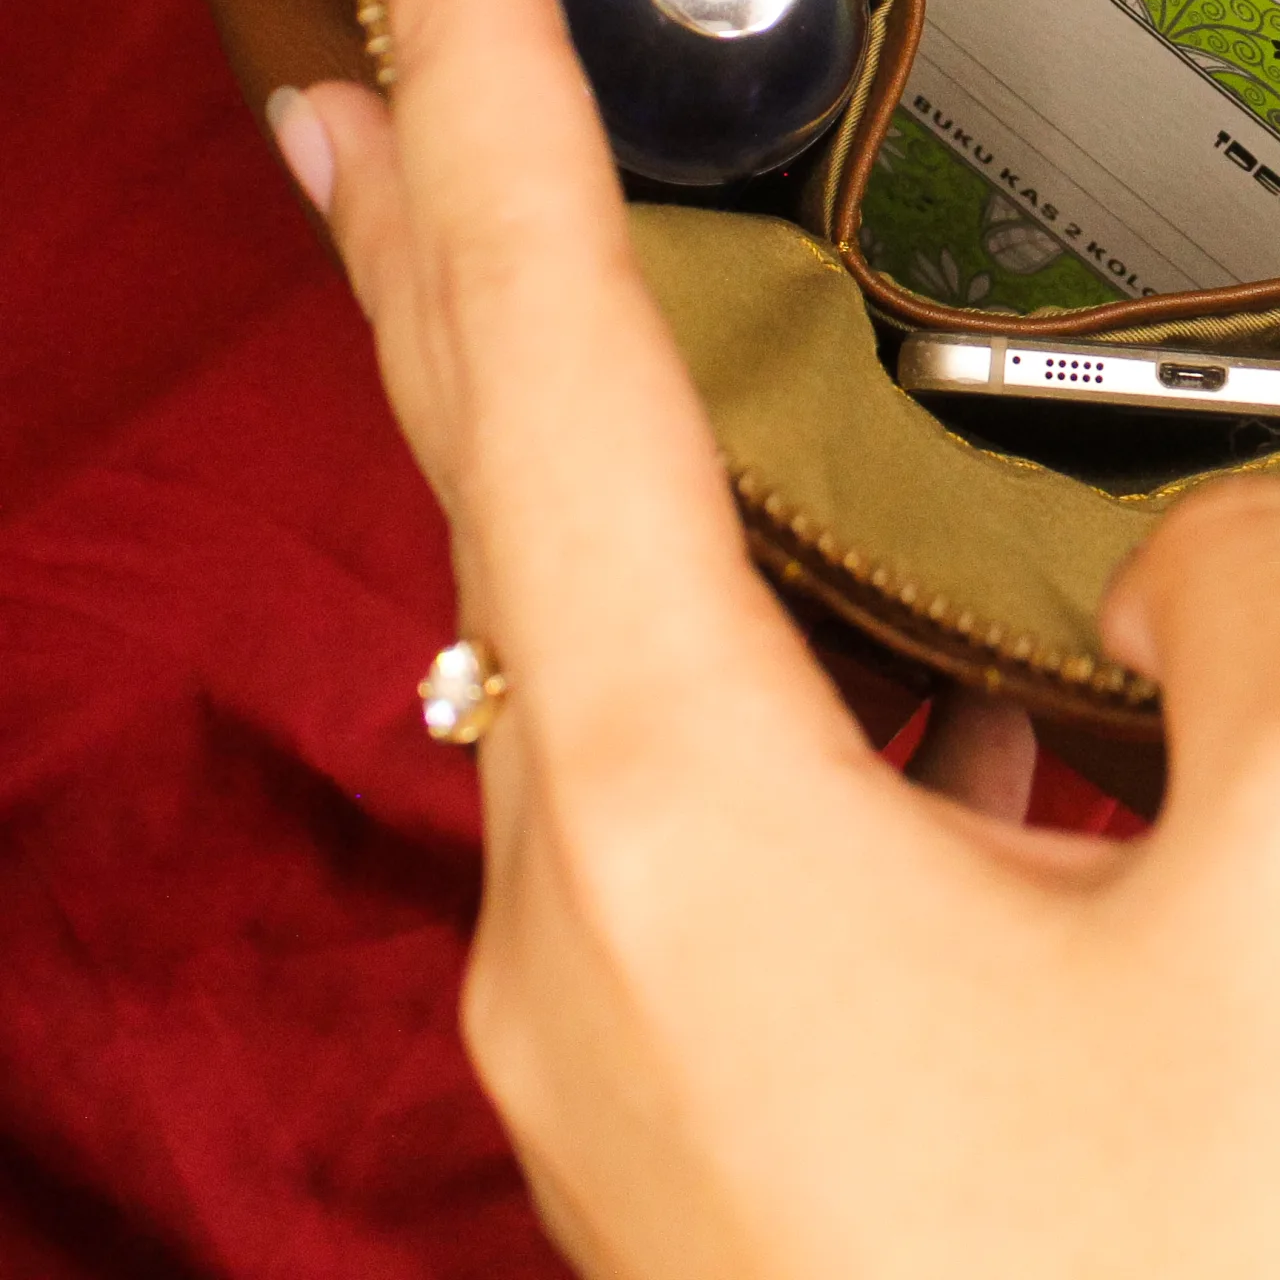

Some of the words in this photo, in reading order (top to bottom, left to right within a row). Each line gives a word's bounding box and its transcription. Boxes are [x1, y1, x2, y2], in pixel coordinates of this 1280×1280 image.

[913, 95, 993, 164] BUKU
[1000, 168, 1059, 221] KAS
[1065, 222, 1082, 239] 2
